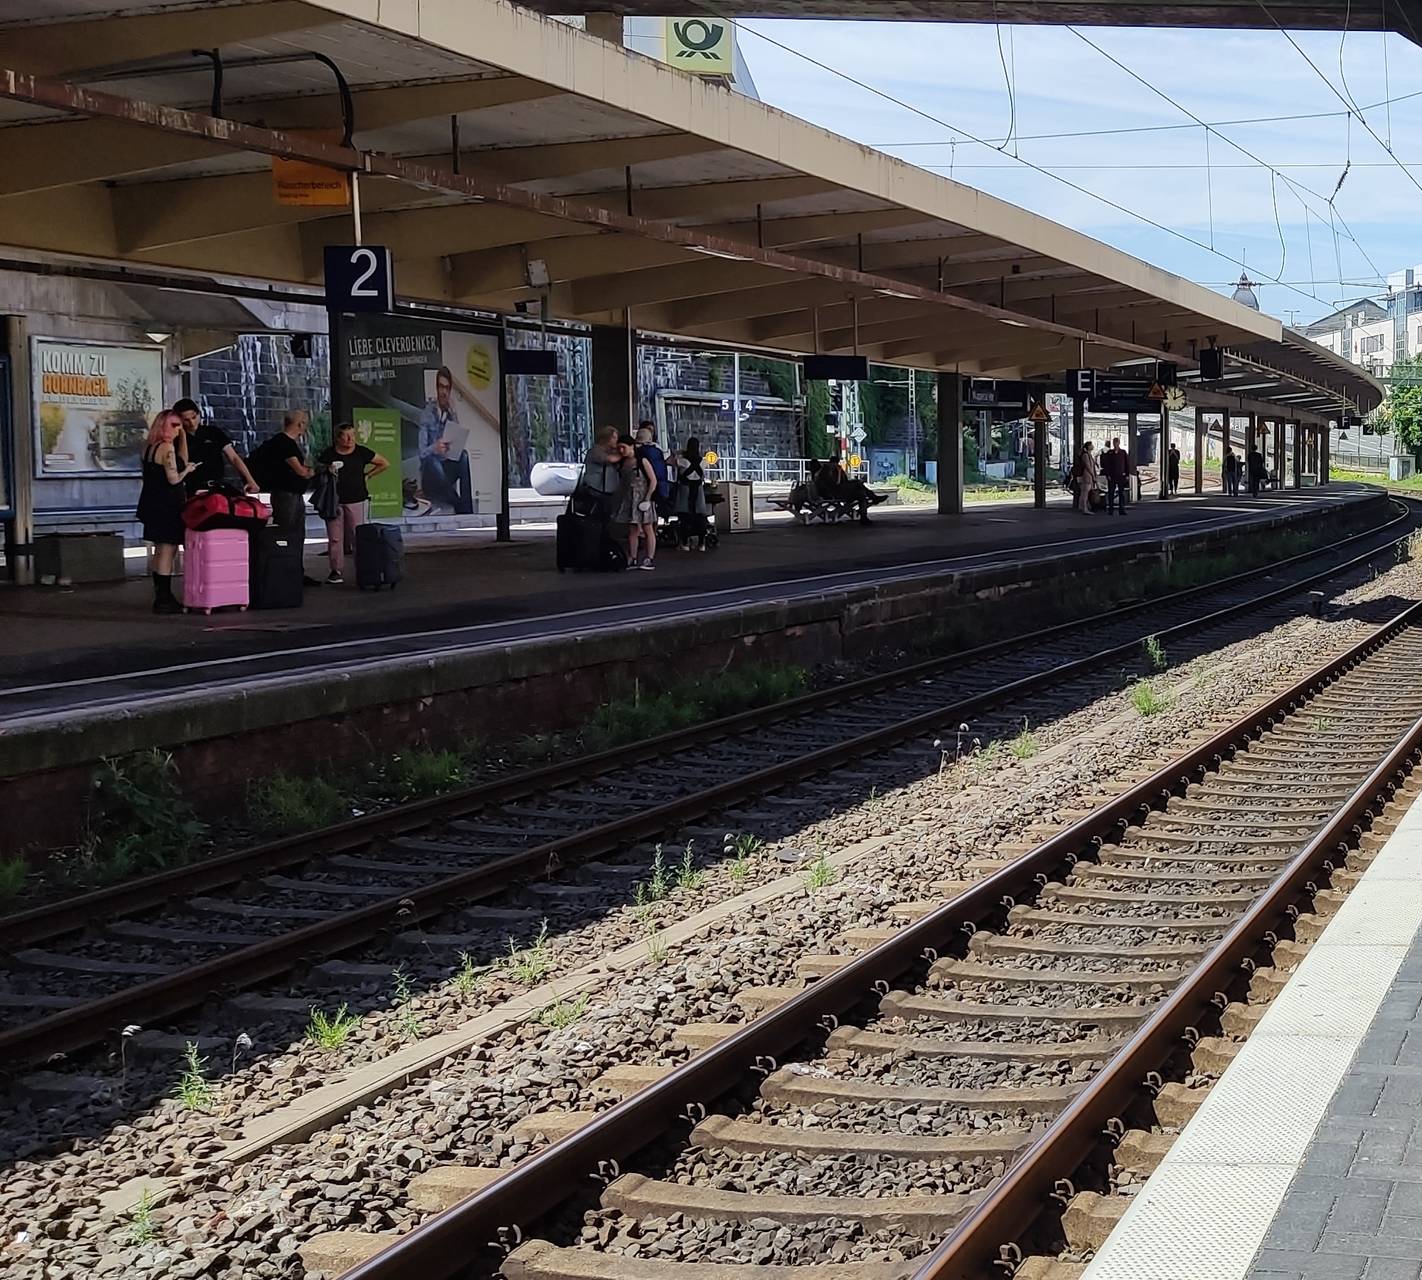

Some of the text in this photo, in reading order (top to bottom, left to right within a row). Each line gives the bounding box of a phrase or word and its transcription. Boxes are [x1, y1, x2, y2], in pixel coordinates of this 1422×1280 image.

[350, 248, 379, 297] 2
[42, 351, 107, 376] KOMM ZU
[1077, 371, 1091, 392] E
[721, 400, 729, 410] 5
[745, 400, 753, 411] 4
[1342, 416, 1349, 428] F
[1366, 425, 1373, 434] 2
[732, 495, 740, 524] Abfall
